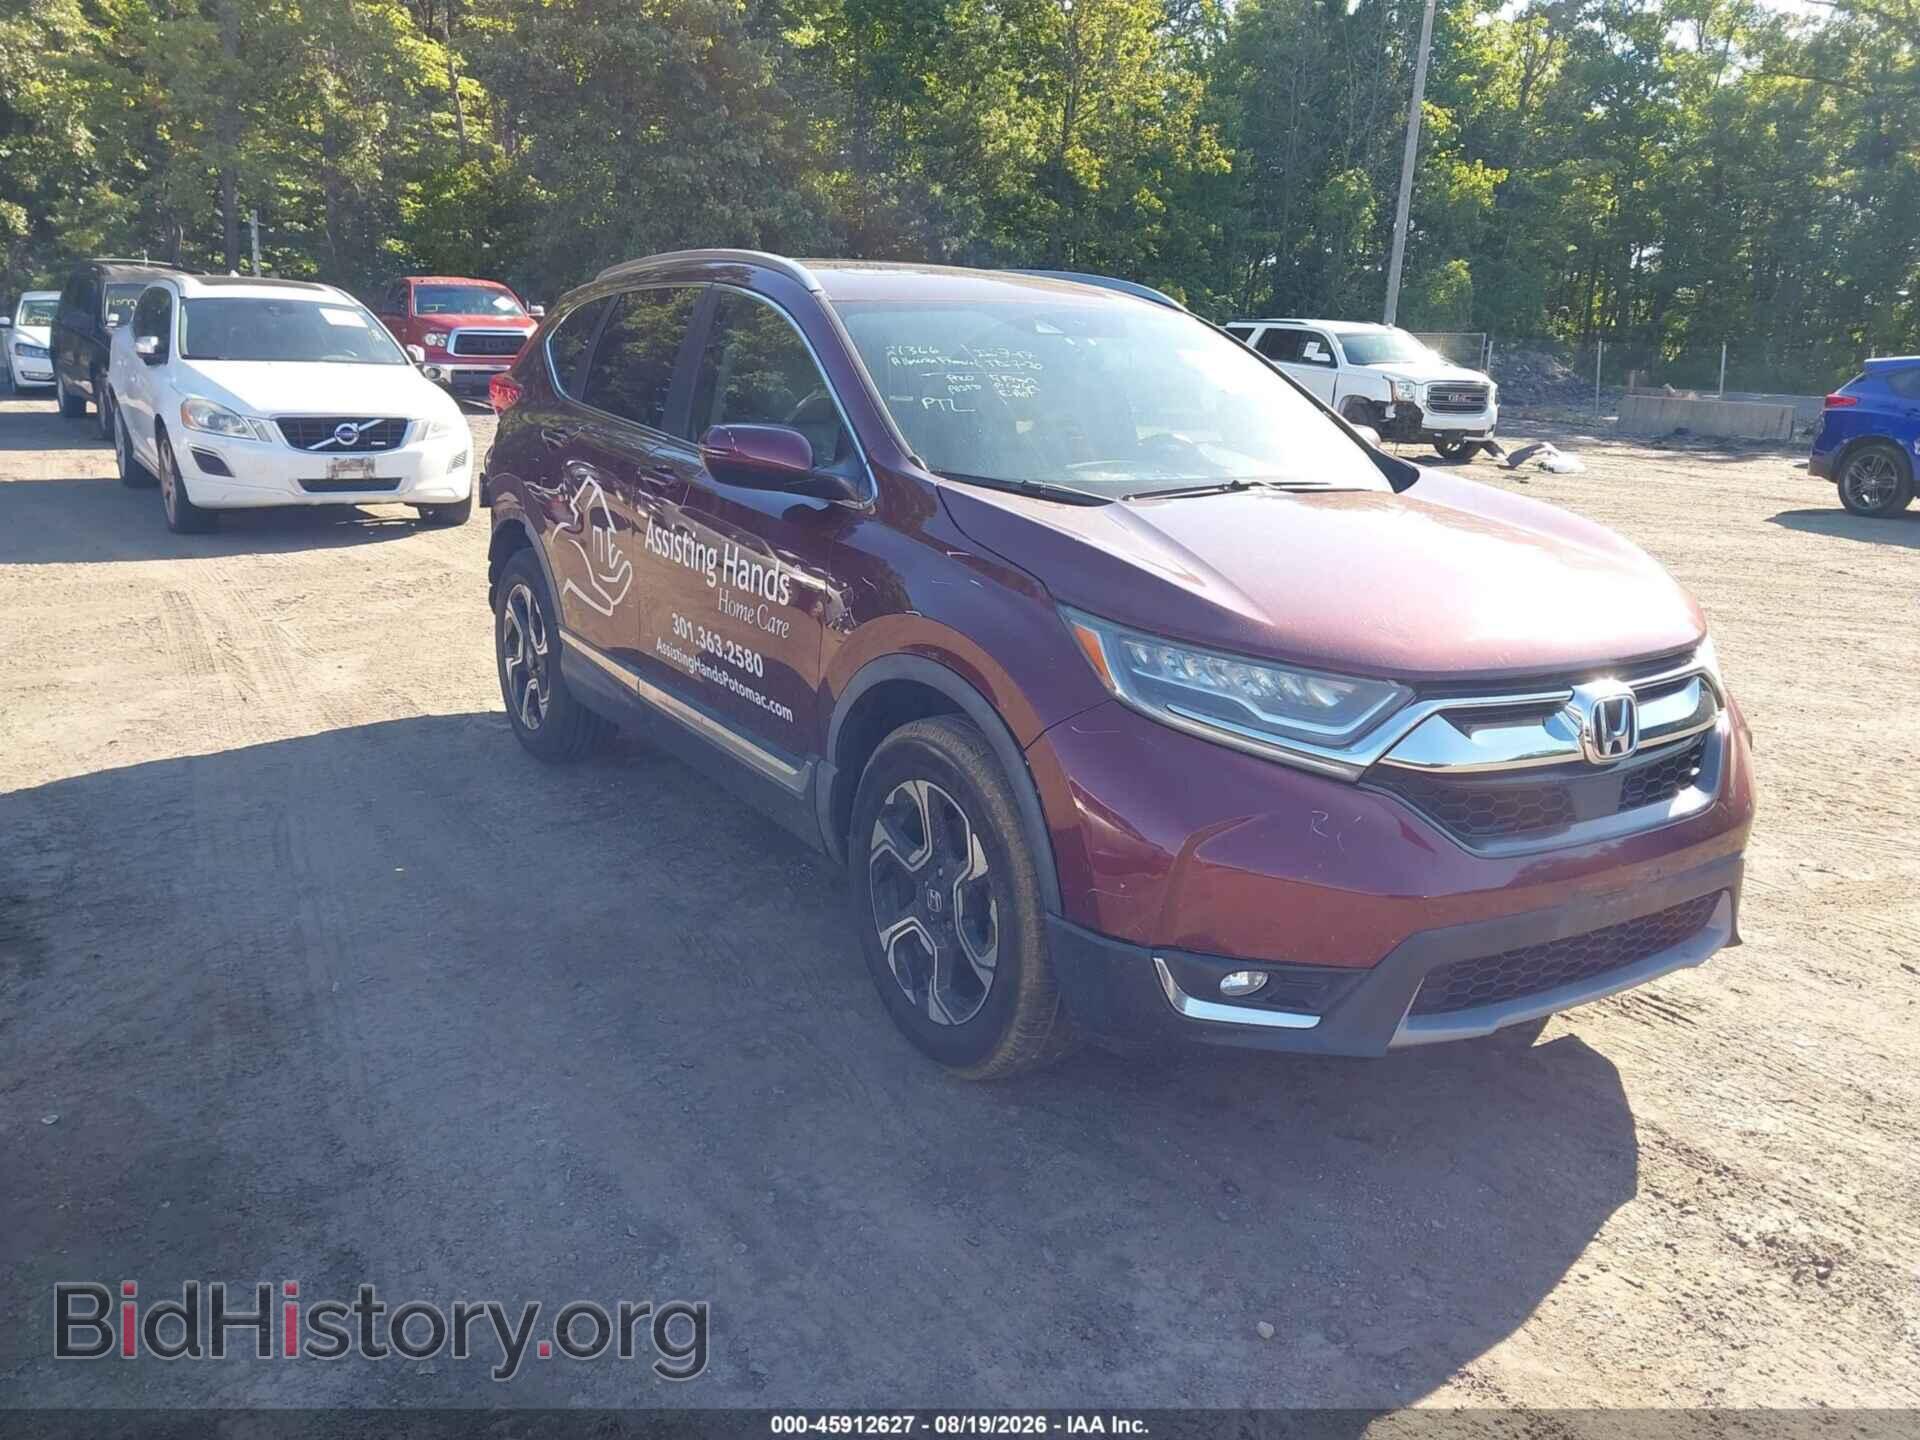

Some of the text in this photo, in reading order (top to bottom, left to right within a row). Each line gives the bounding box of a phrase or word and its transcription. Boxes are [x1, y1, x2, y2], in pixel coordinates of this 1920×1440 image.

[644, 516, 790, 606] Assisting Hands
[671, 612, 764, 678] 301.363.2580
[717, 587, 790, 639] Home Care
[656, 637, 794, 723] AssistingHandsPotomac.com
